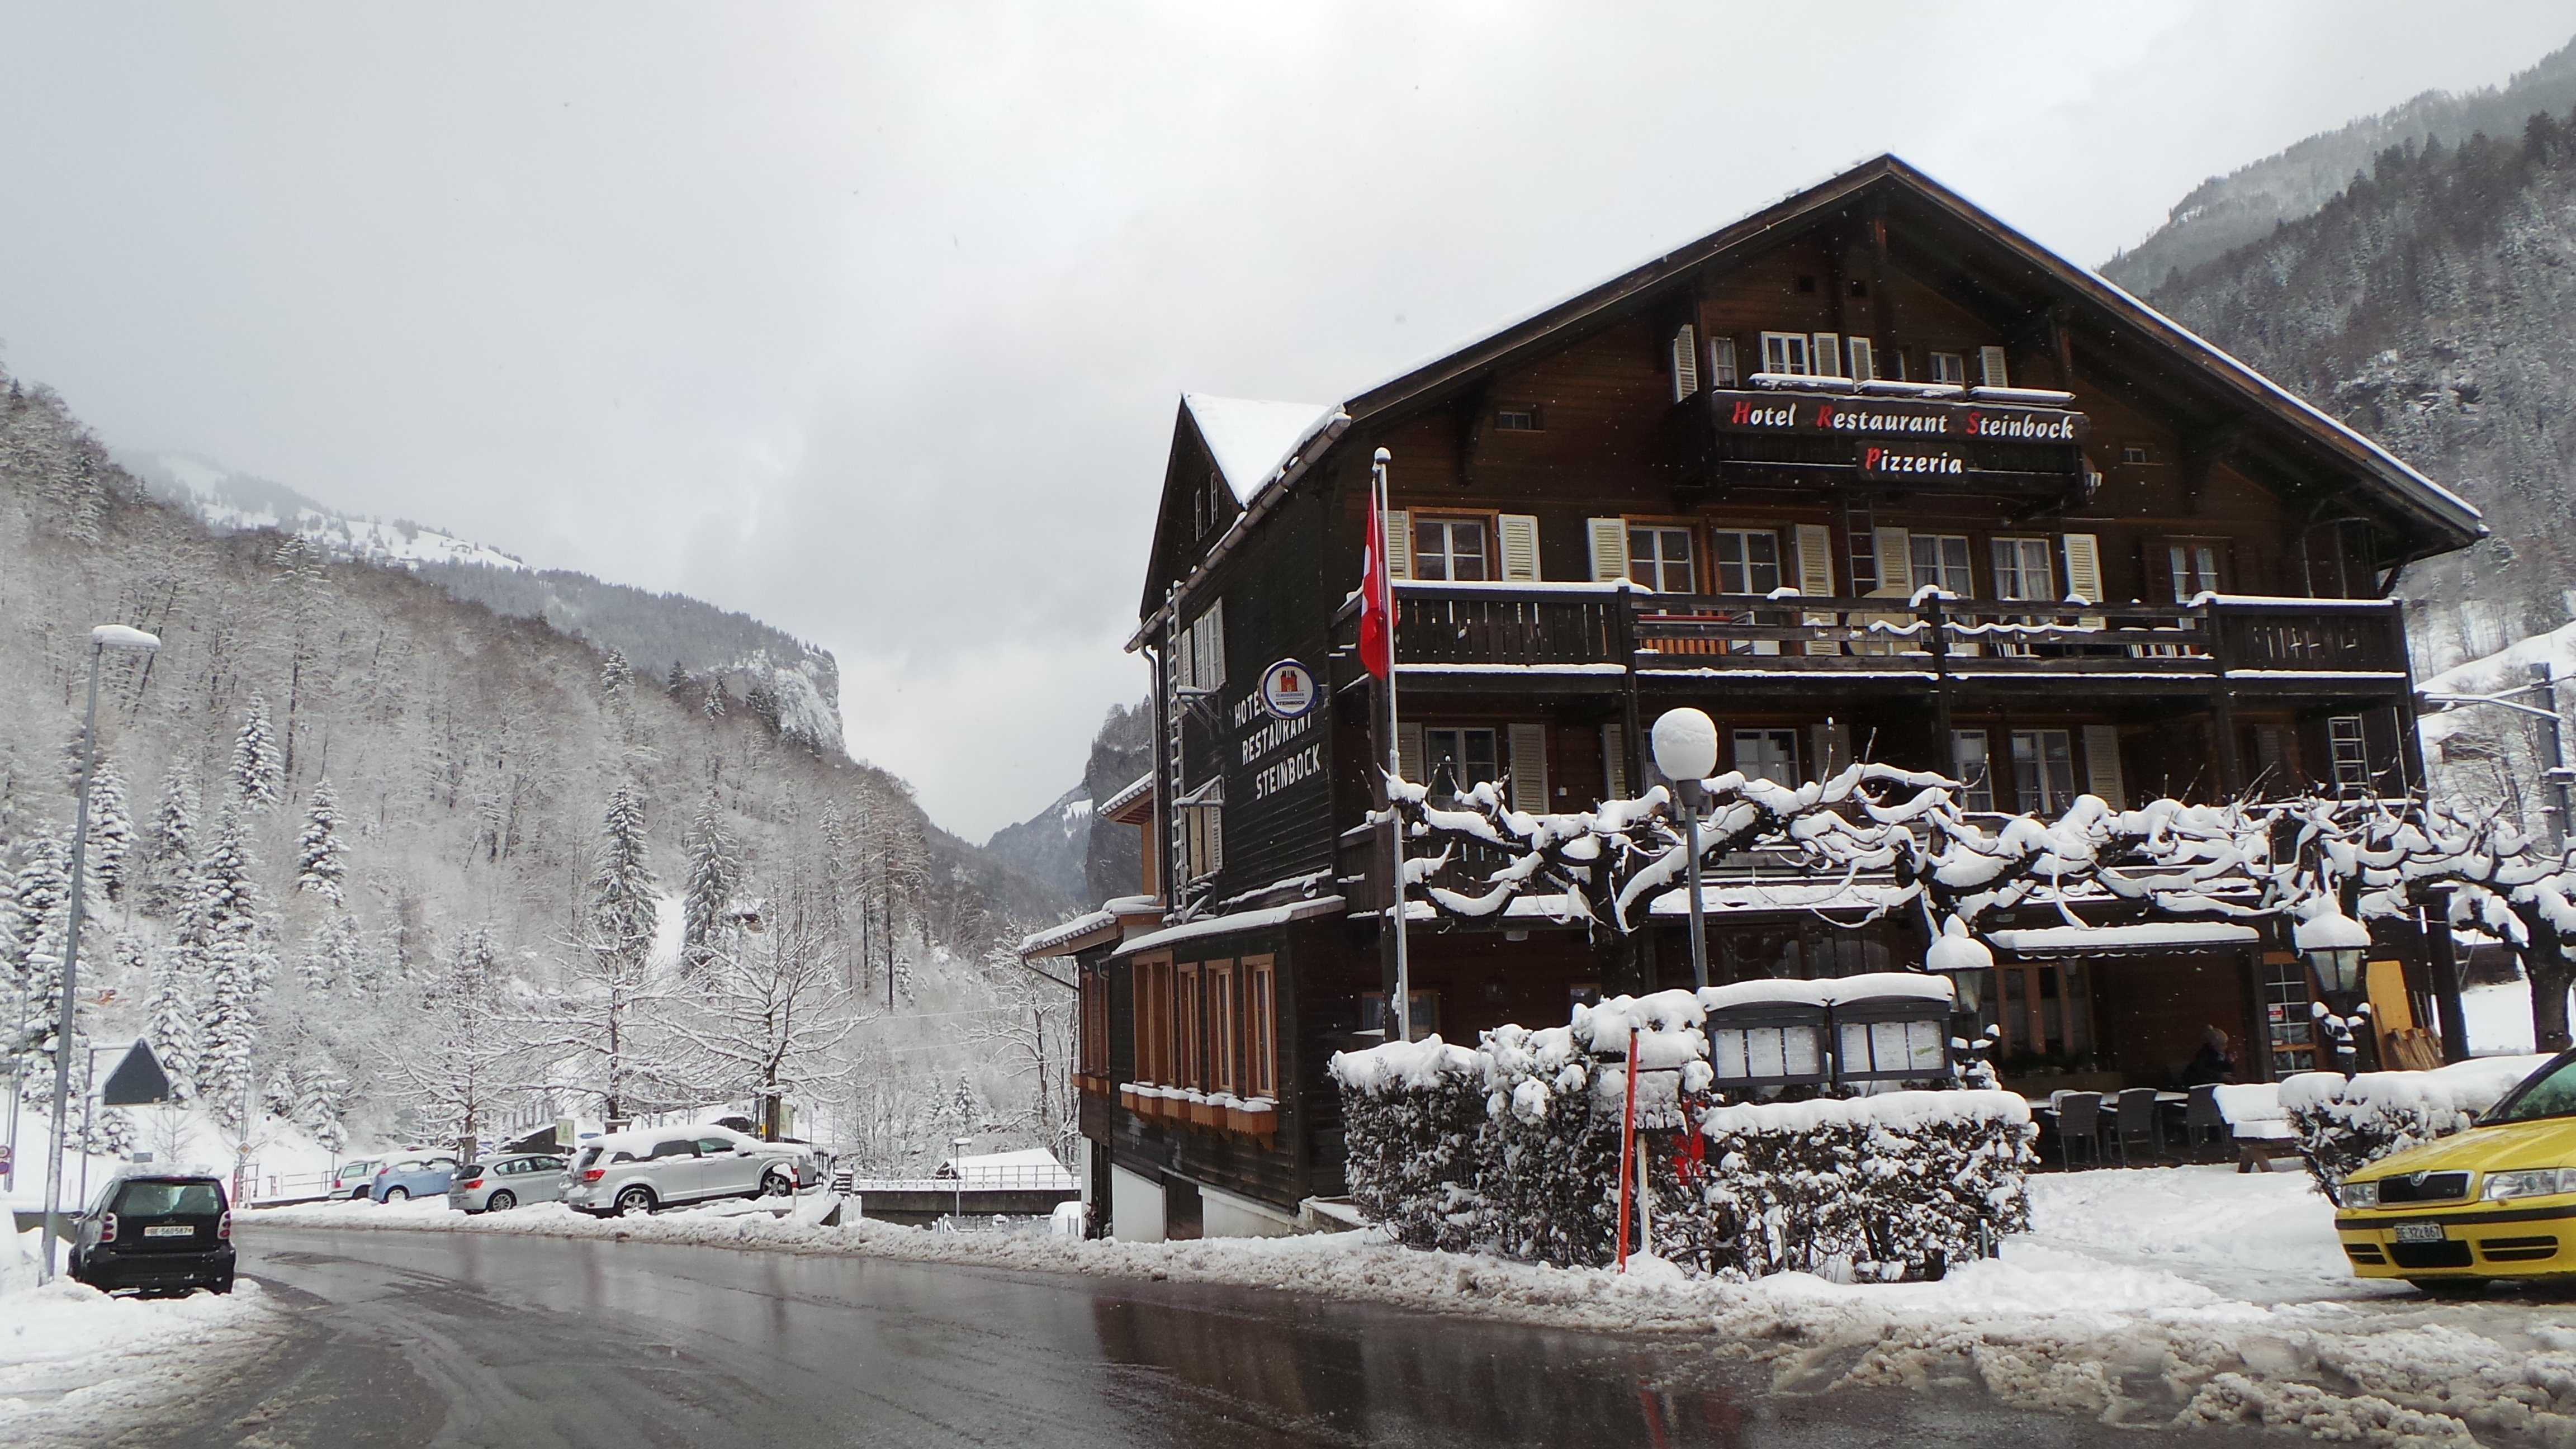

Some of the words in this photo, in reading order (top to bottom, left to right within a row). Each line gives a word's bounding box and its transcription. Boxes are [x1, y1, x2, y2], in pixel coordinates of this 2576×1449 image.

[1732, 401, 1797, 427] Hotel
[1816, 405, 1948, 434] Restaurant
[1965, 411, 2075, 439] Steinbock
[1864, 447, 1963, 474] Pizzeria
[1234, 691, 1265, 728] HOTE
[1256, 742, 1320, 800] STEINBOCK
